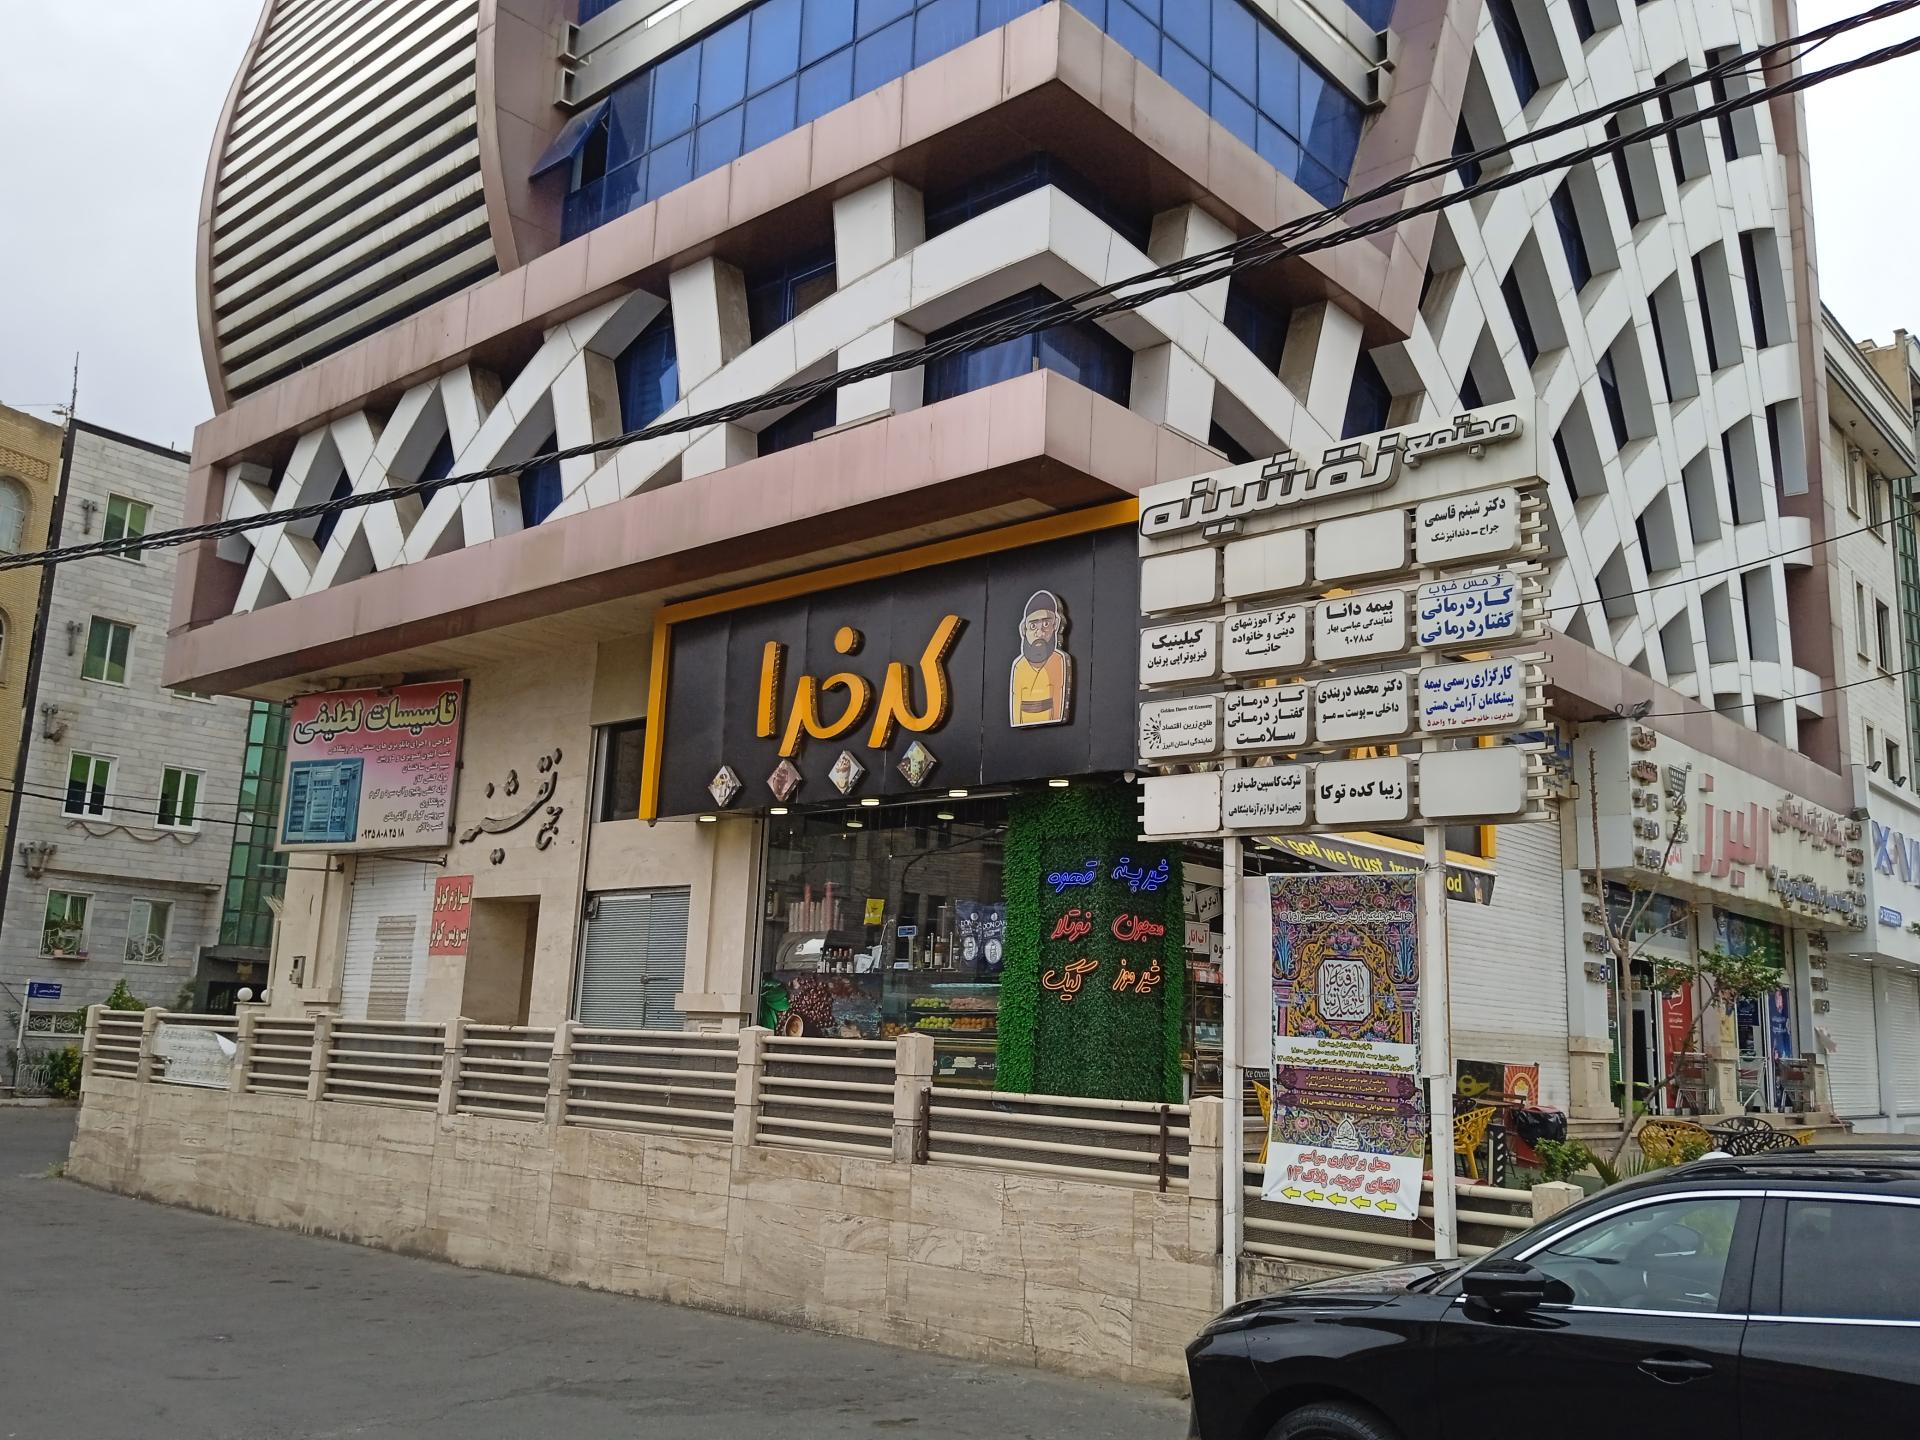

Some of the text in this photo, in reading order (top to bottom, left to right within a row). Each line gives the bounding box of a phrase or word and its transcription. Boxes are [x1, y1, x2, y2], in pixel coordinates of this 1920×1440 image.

[1139, 413, 1521, 540] مجتمع نقشینه
[1424, 497, 1506, 527] دکتر شبنم قاسمی
[1480, 524, 1499, 535] جراح
[1428, 581, 1457, 595] خوب
[1326, 600, 1394, 619] بیمه دانا
[1231, 612, 1296, 632] مرکز آموزشهای
[1327, 615, 1393, 635] نمایندگی عباسی بهار
[1232, 626, 1295, 644] دینی و خانواده
[1245, 642, 1281, 655] حانیه
[1147, 655, 1169, 669] پرنیان
[1318, 678, 1403, 704] دکتر محمد دربندی
[1424, 679, 1441, 692] بیمه
[1443, 676, 1469, 692] رسمی
[1227, 689, 1305, 711] کار درمانی
[1425, 691, 1514, 715] پیشگامان آرامش هستی
[293, 691, 459, 744] تاسیسات لطیفی
[1227, 707, 1305, 728] گفتار درمانی
[1322, 702, 1399, 723] داخلی پوست مو
[1162, 719, 1213, 731] طلوع زرین اقتصاد
[1162, 737, 1213, 750] نمایندگی استان البرز
[1236, 726, 1296, 745] سلامت
[1244, 777, 1257, 790] طب
[1257, 776, 1282, 793] کاسپین
[1281, 774, 1302, 791] شرکت
[1320, 781, 1403, 804] زیبا کده توکا
[1275, 806, 1280, 814] و
[1279, 802, 1302, 816] تجهیزات
[1694, 773, 1770, 887] البرز
[1047, 860, 1098, 893] قهوه
[1111, 857, 1169, 893] شیر پسته
[1287, 840, 1324, 859] god
[1320, 847, 1348, 865] we
[1348, 852, 1384, 873] trust
[1447, 873, 1463, 893] od
[1051, 909, 1093, 942] نوتلا
[1112, 913, 1165, 942] معجون
[1043, 958, 1099, 1001] کیک
[1113, 959, 1161, 993] شیر موز
[1298, 1150, 1326, 1166] مراسم
[1368, 1157, 1391, 1173] محل
[1301, 1168, 1329, 1188] پلاک
[1365, 1176, 1400, 1195] انتهای
